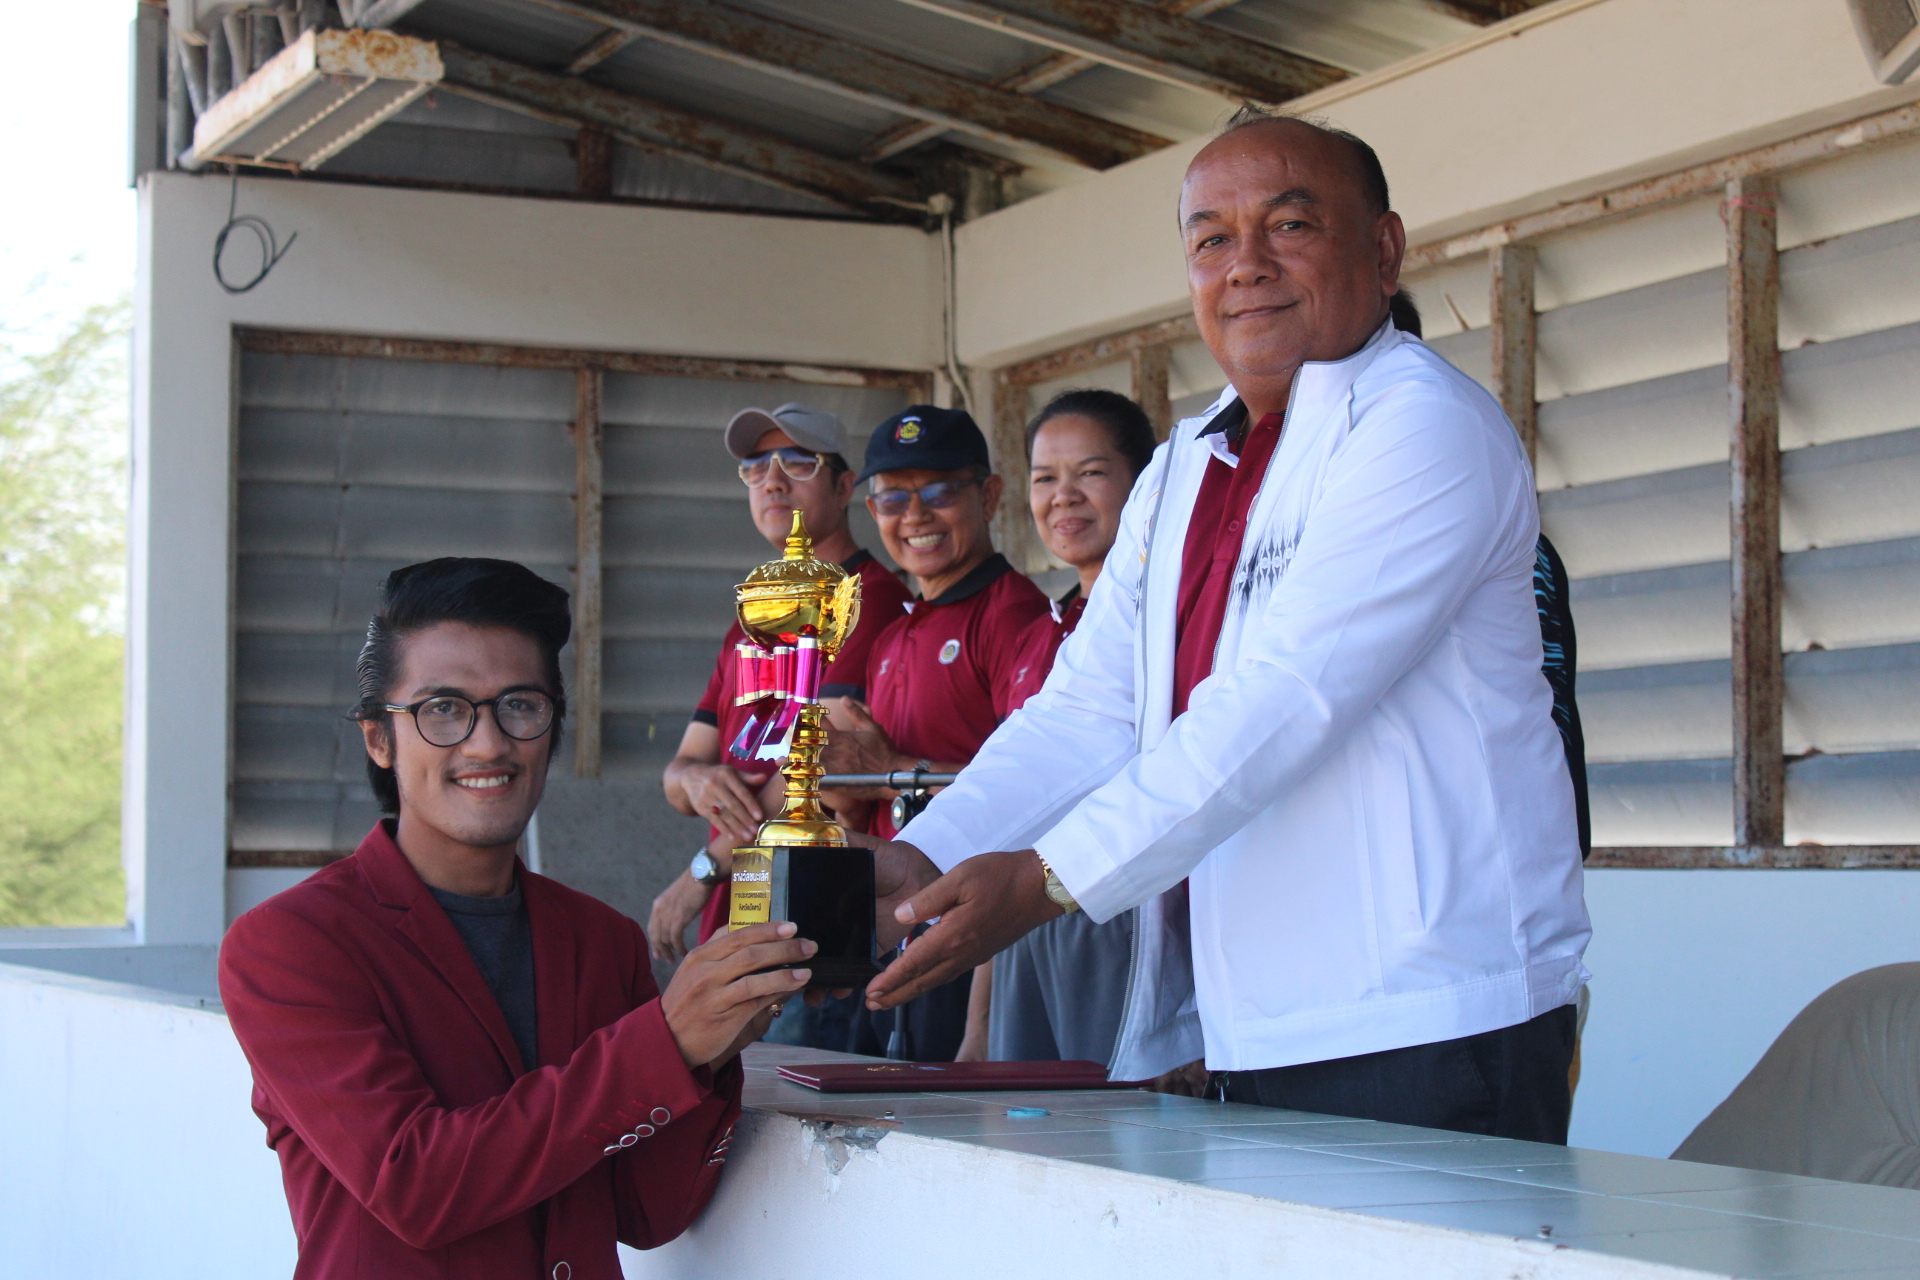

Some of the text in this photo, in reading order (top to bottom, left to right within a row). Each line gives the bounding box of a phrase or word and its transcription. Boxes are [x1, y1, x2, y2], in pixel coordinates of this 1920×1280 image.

[733, 869, 769, 882] รางวัลชนะเลิศ
